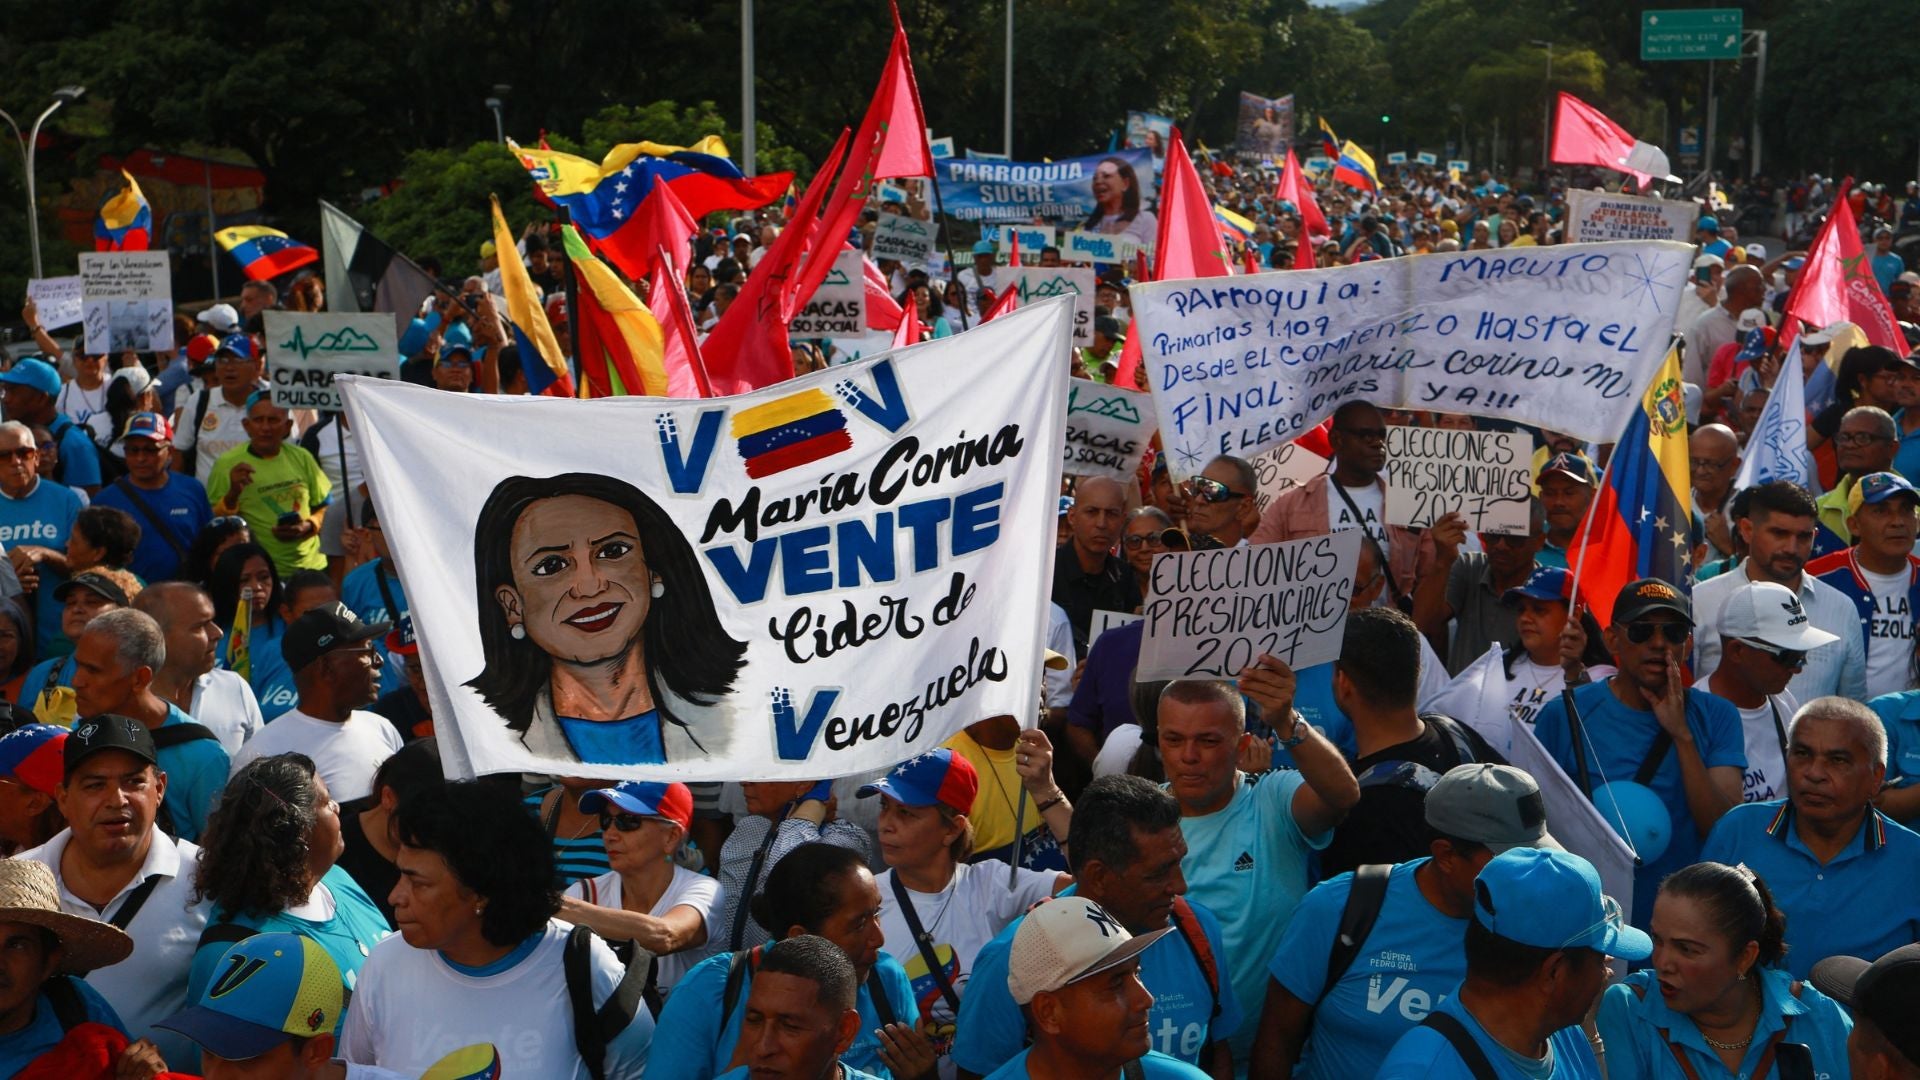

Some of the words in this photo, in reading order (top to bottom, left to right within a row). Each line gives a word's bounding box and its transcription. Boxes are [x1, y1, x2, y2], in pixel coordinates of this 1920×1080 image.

[950, 162, 1083, 183] PARROQUIA
[980, 183, 1055, 203] SUCRE
[955, 207, 983, 220] CON
[1032, 204, 1084, 218] CORINA
[1594, 208, 1661, 220] JUBILADOS
[1600, 201, 1663, 213] BOMBEROS
[1582, 220, 1597, 228] YA
[1604, 222, 1675, 234] CUMPLIMOS
[1590, 214, 1605, 222] DE
[1614, 218, 1668, 227] CARACAS
[876, 235, 928, 252] CARACAS
[1581, 228, 1604, 236] CON
[1610, 231, 1625, 239] EL
[1629, 232, 1673, 240] ESTADO
[1439, 253, 1609, 283] MACUTO
[814, 320, 860, 332] SOCIAL
[1266, 316, 1330, 338] 1.109
[1163, 359, 1238, 392] Desde
[277, 391, 331, 406] PULSO
[1220, 378, 1380, 454] ELECCIONES
[1066, 426, 1137, 454] RACAS
[1386, 427, 1514, 465] ELECCIONES
[1075, 448, 1126, 470] SOCIAL
[700, 471, 869, 543] María
[868, 423, 1024, 505] Corina
[1386, 459, 1532, 502] PRESIDENCIALES
[1339, 508, 1351, 523] A
[0, 520, 57, 541] ente
[705, 481, 1005, 605] VENTE
[1152, 538, 1338, 596] ELECCIONES
[933, 572, 976, 626] de
[1146, 577, 1350, 638] PRESIDENCIALES
[1886, 596, 1908, 615] LA
[1871, 619, 1917, 640] EZOLA
[771, 636, 1008, 762] Venezuela
[1743, 769, 1766, 791] ON
[1370, 958, 1396, 968] PEDRO
[1397, 961, 1418, 972] GUAL
[1381, 950, 1411, 962] CÚPIRA
